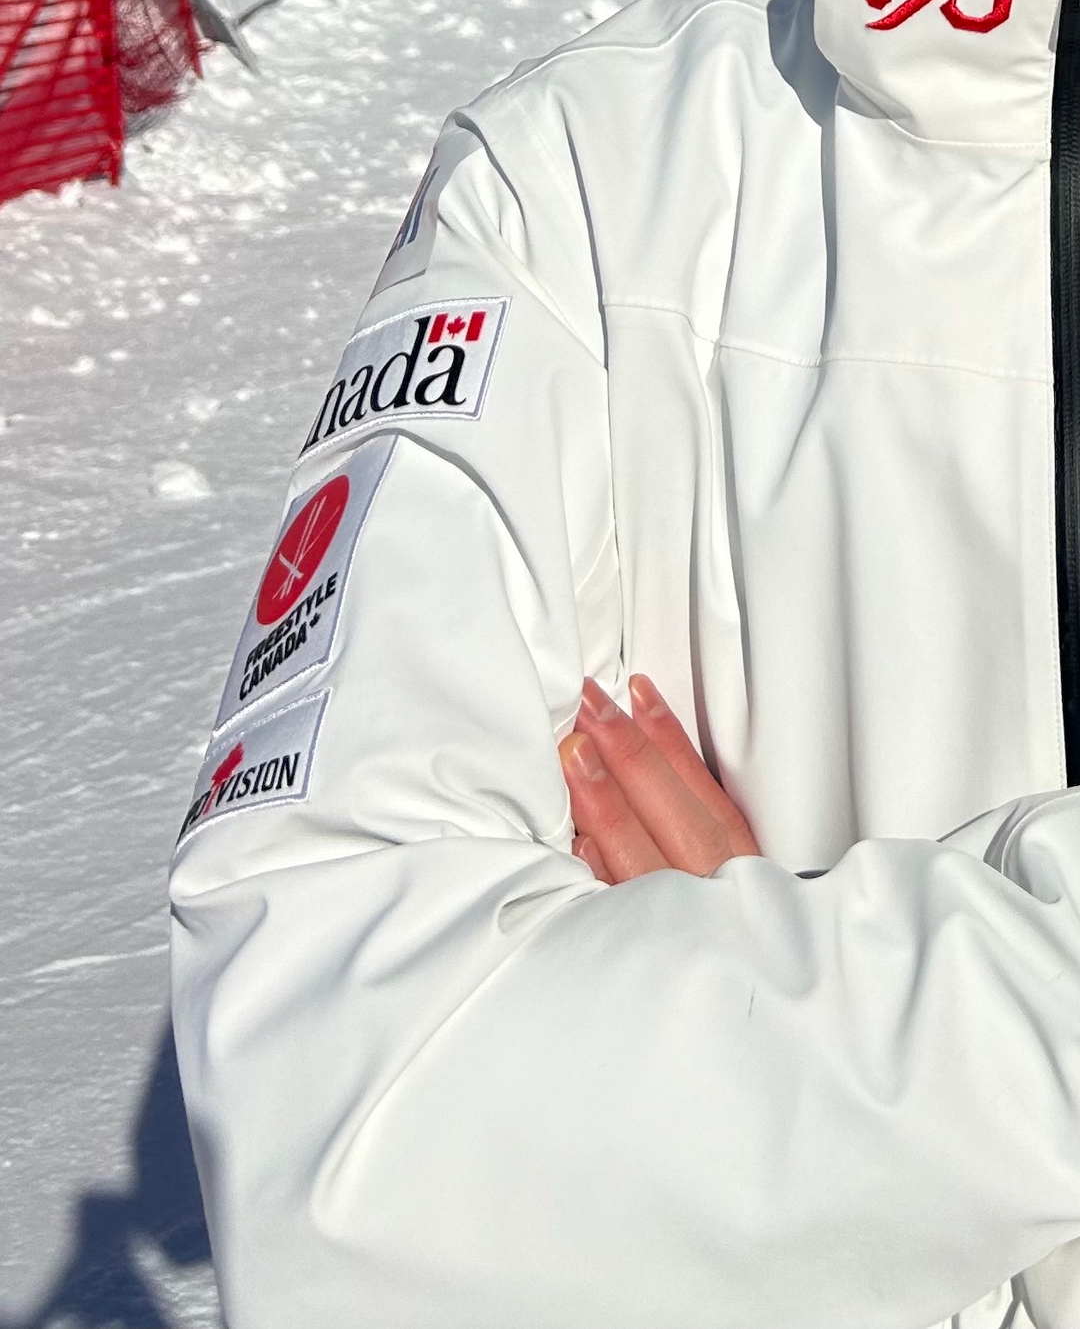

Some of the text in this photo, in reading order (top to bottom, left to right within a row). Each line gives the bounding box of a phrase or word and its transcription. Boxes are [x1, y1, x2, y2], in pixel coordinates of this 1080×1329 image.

[299, 315, 467, 458] nada
[239, 621, 308, 701] CANADA
[243, 571, 339, 675] FREESTYLE
